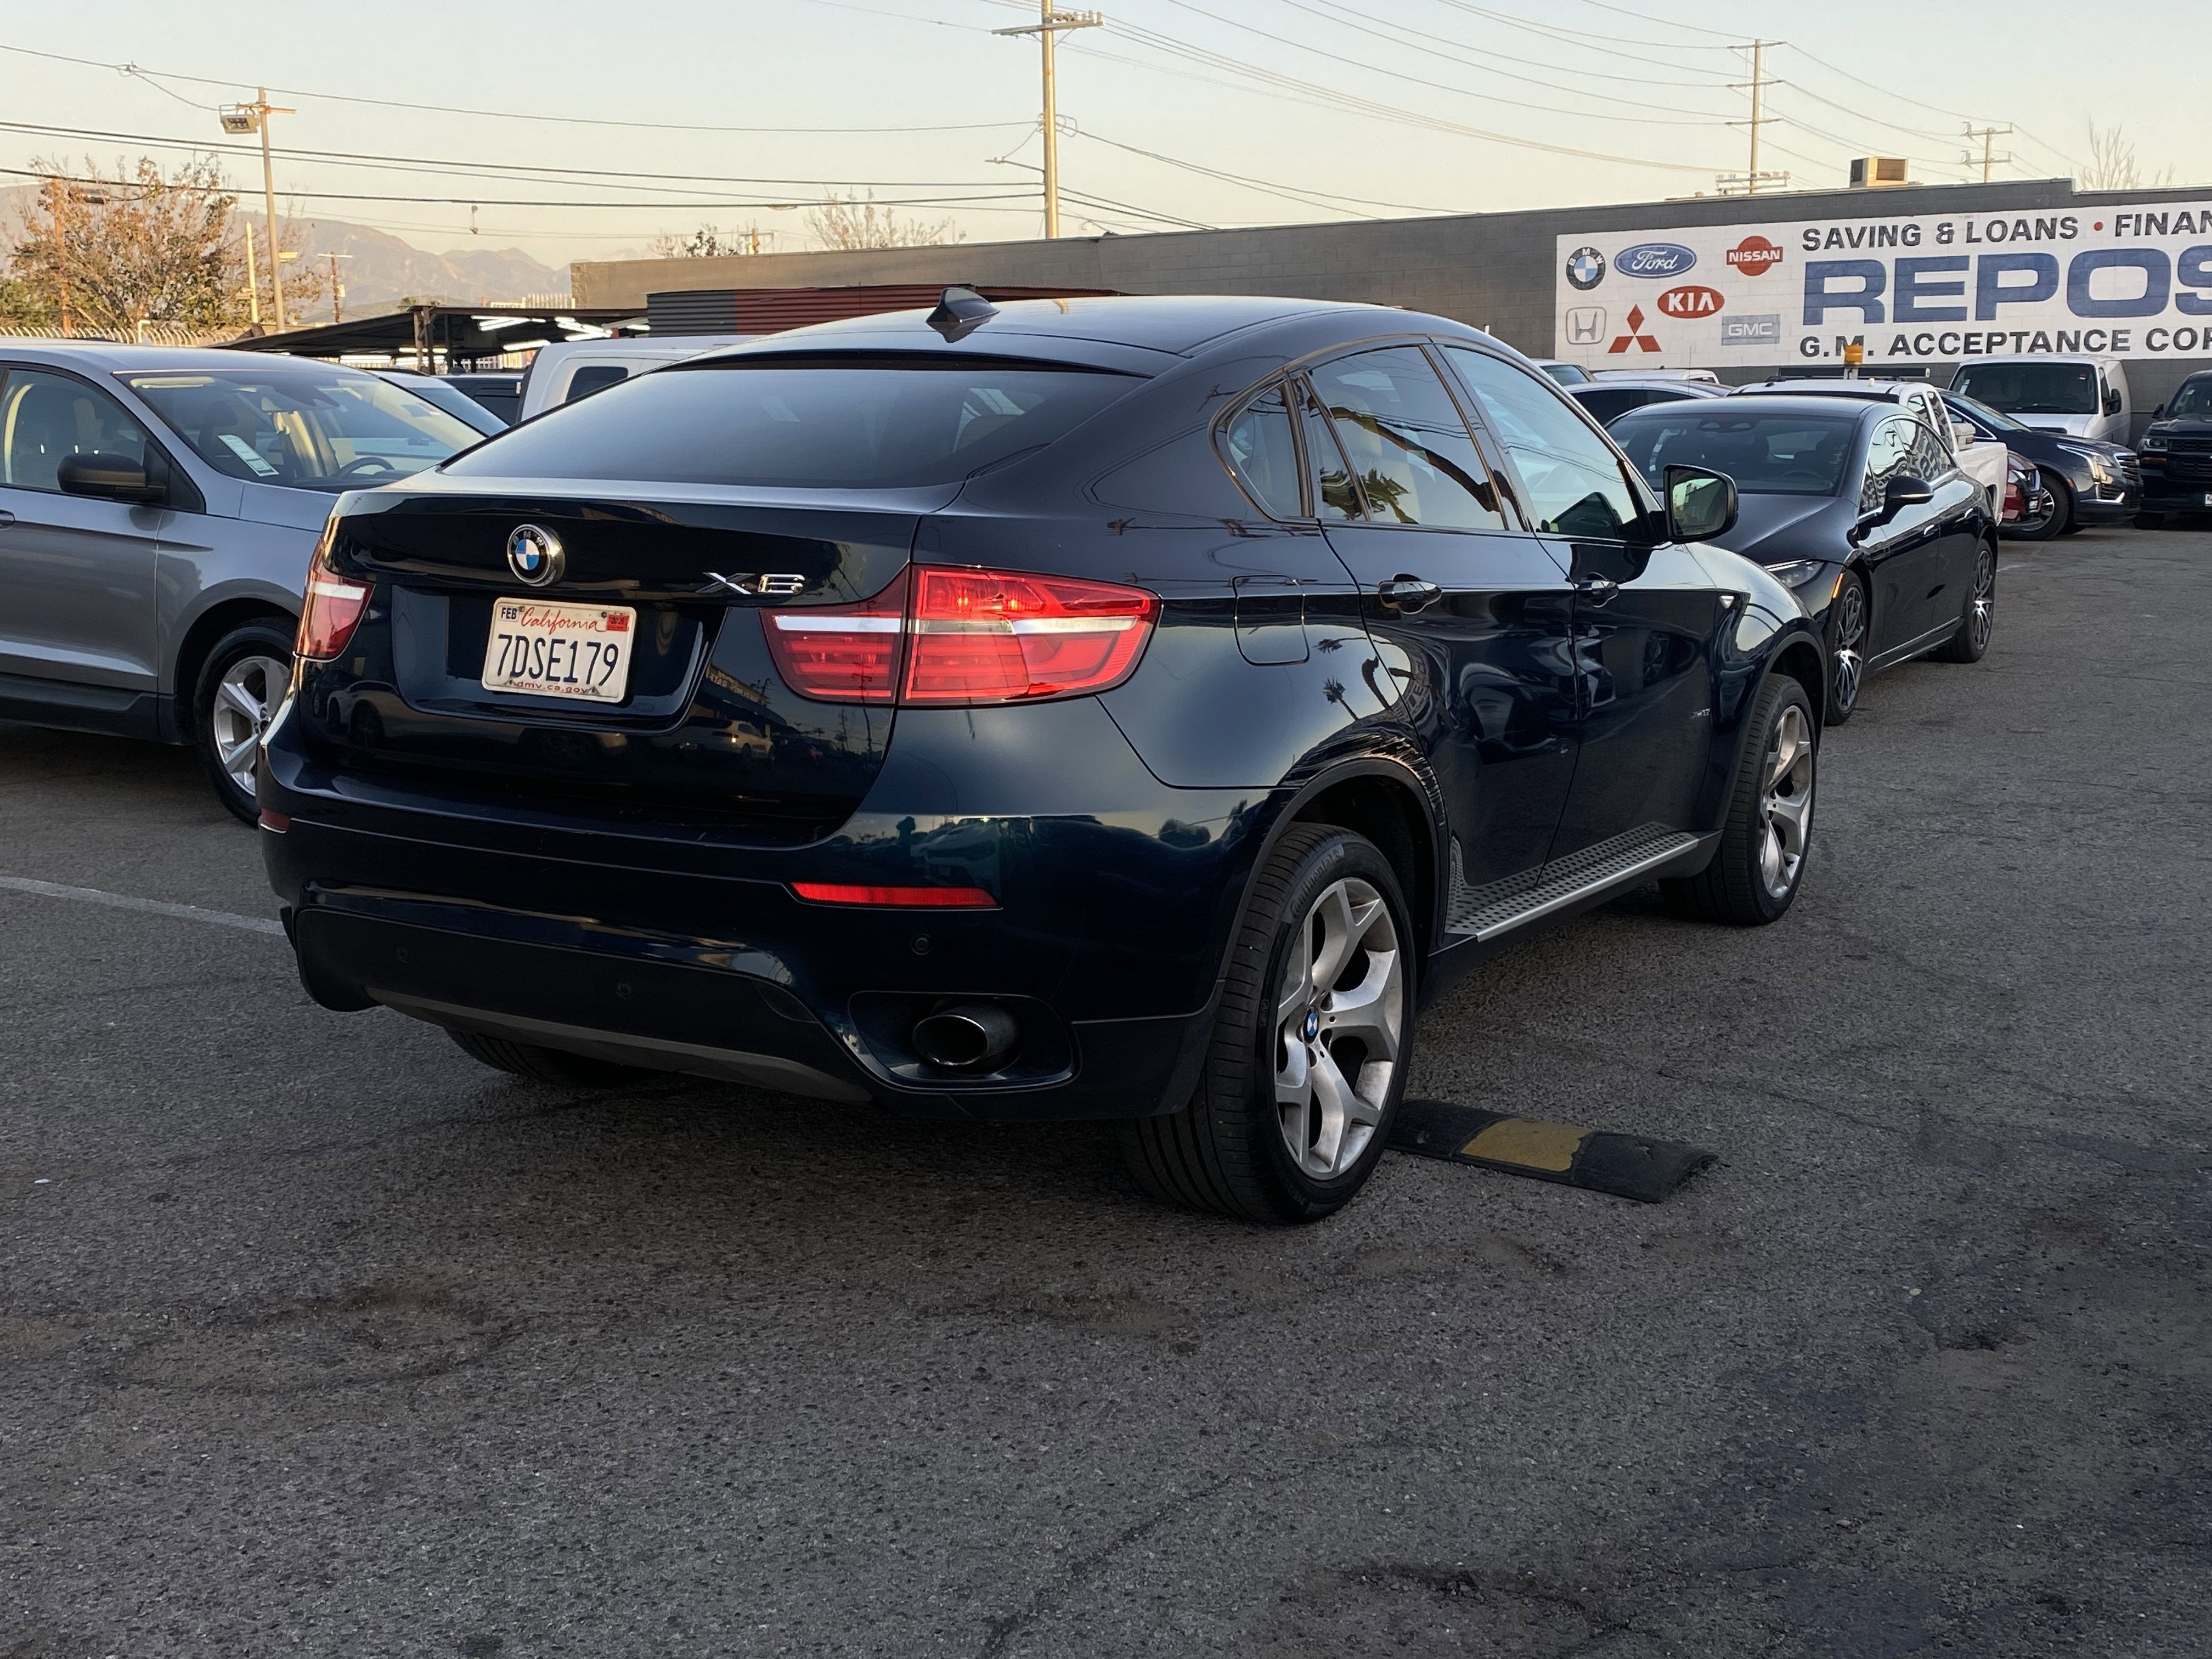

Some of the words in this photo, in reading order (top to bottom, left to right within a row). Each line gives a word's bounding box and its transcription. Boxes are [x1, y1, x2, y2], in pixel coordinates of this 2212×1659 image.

[1802, 224, 1921, 251] SAVING
[1936, 222, 1955, 244] &
[1966, 216, 2079, 244] LOANS
[1568, 248, 1604, 267] BMW
[1632, 250, 1679, 270] Ford
[1729, 249, 1781, 263] NISSAN
[1667, 292, 1716, 312] KIA
[1728, 322, 1773, 337] GMC
[1888, 329, 2131, 356] ACCEPTANCE
[512, 530, 545, 546] BMW
[695, 572, 806, 595] X6
[500, 607, 517, 619] FEB
[521, 606, 606, 635] California
[497, 634, 619, 686] 7DSE179
[517, 679, 589, 694] dmv.ca.gov
